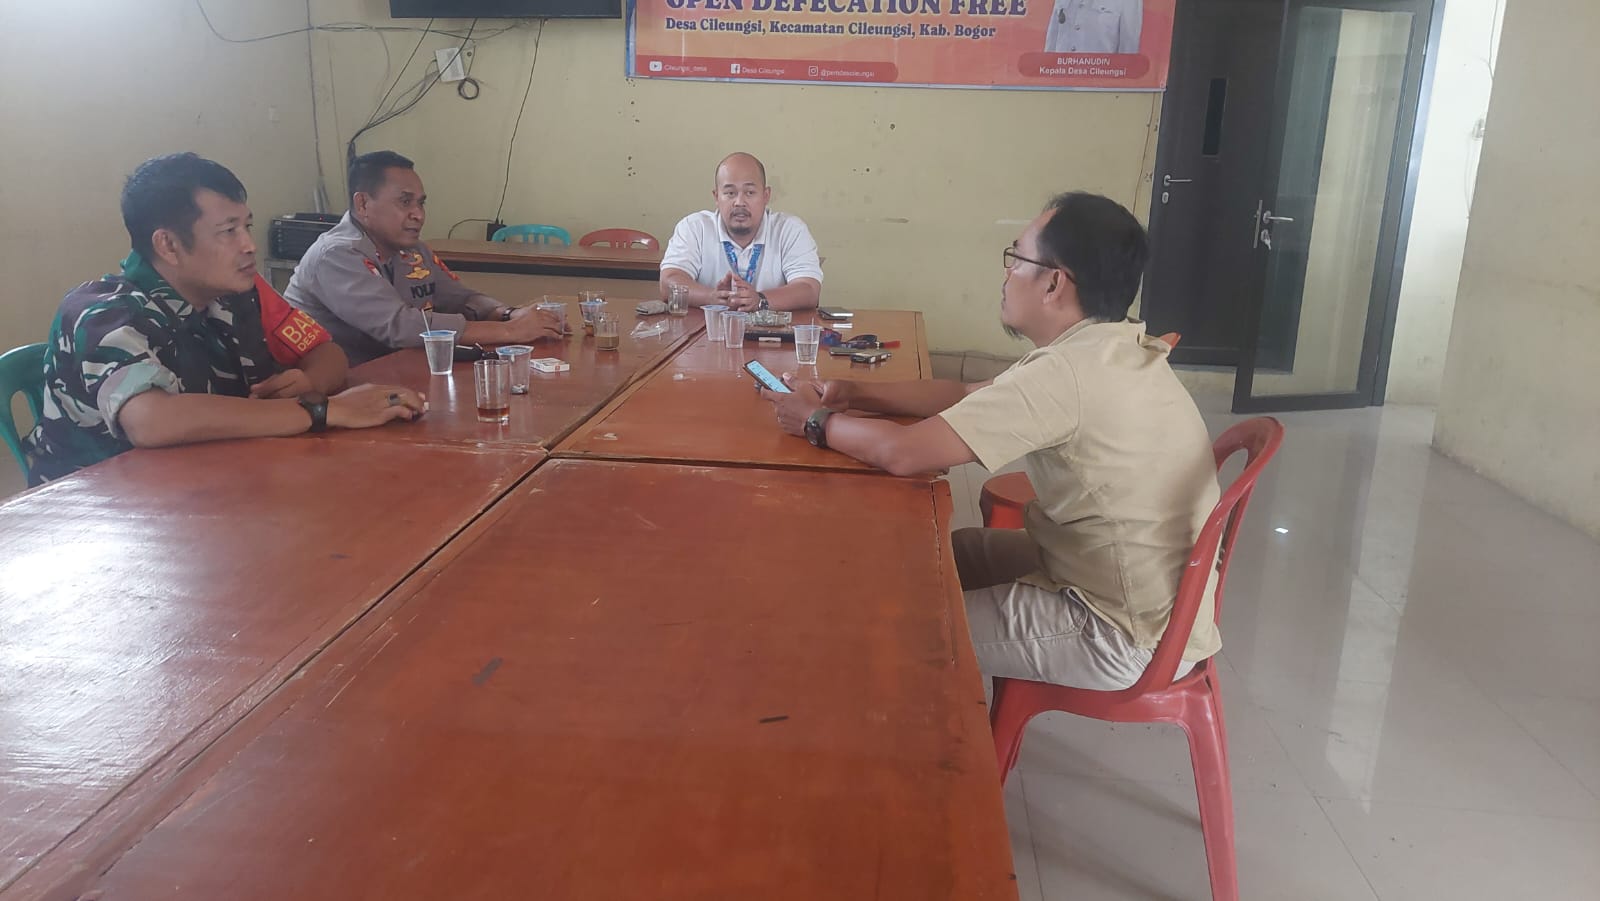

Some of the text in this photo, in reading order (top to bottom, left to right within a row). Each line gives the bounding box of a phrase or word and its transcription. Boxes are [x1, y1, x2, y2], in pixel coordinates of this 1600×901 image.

[667, 0, 1027, 16] OPEN DEFECATION FREE
[666, 17, 996, 40] Desa Cileungsi, Kecamatan Cileungsi, Kab. Bogor
[1057, 57, 1111, 65] BURHANUDIN
[1039, 66, 1127, 77] Kepala Desa Cileungsi
[297, 328, 321, 352] DESA
